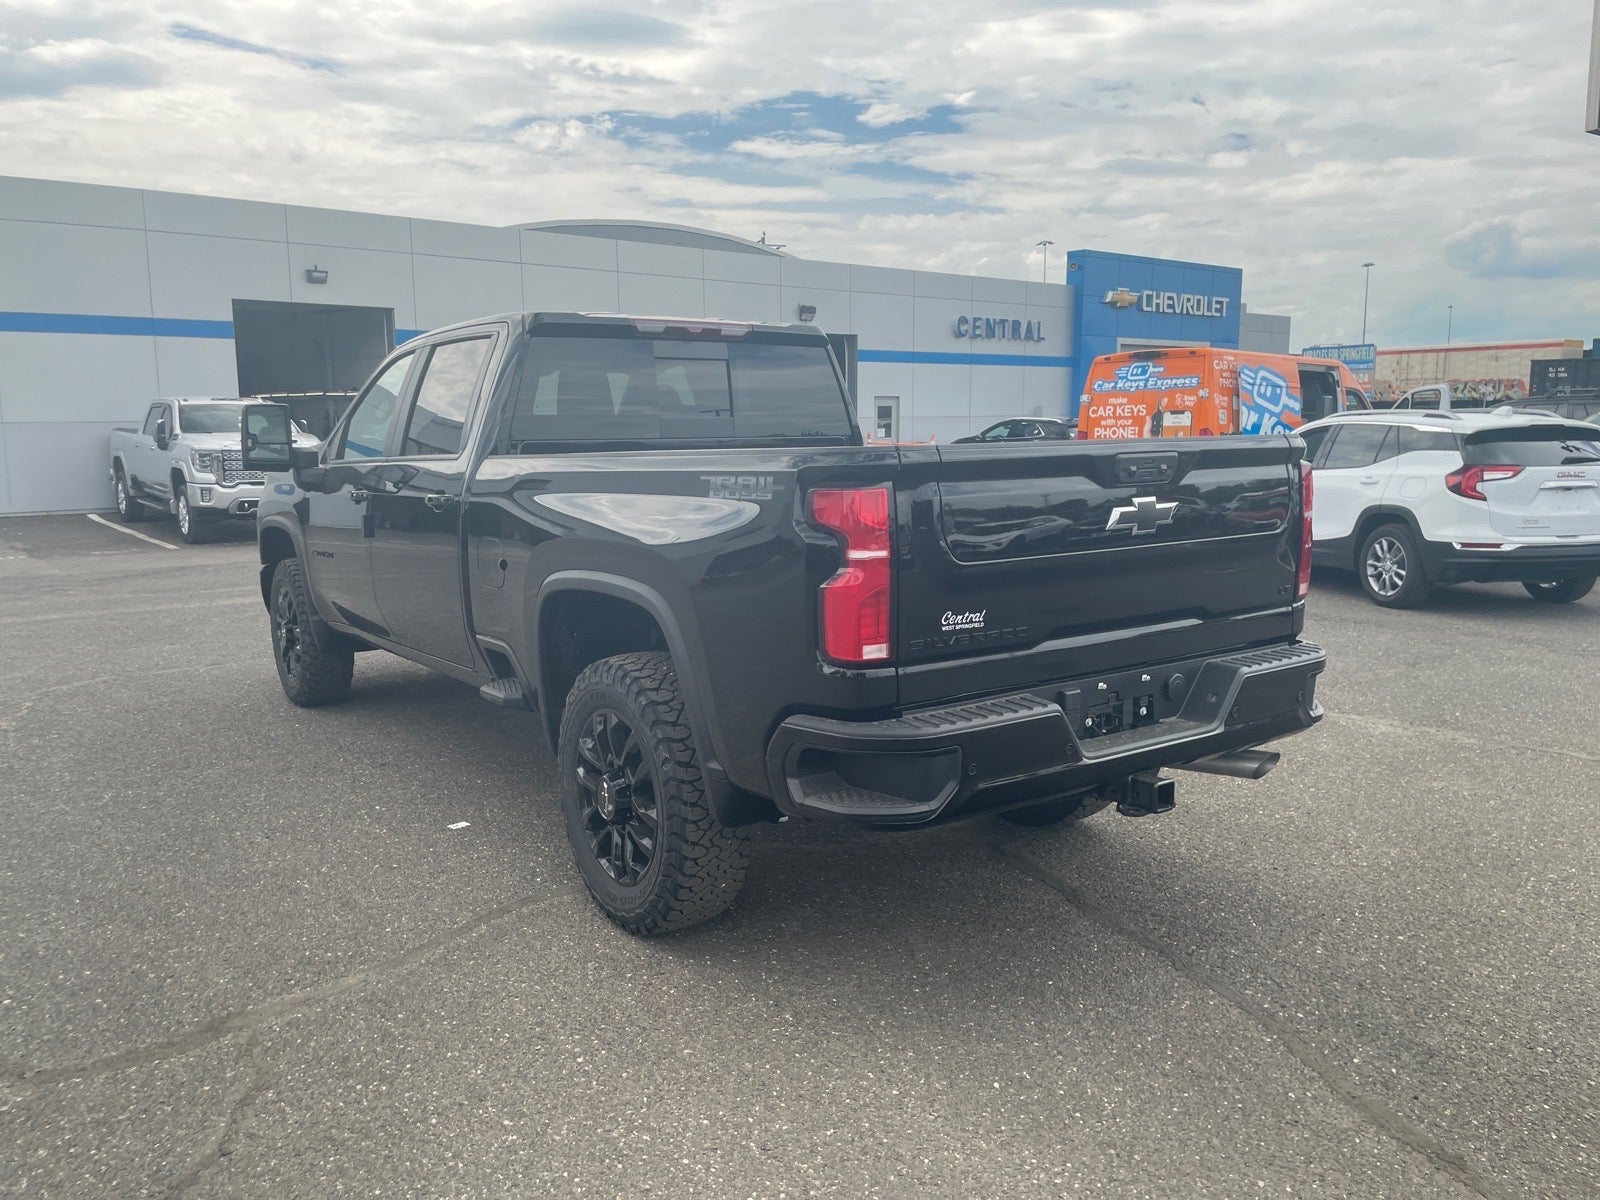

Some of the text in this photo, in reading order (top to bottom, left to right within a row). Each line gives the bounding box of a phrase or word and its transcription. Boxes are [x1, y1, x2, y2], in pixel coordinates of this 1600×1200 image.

[1142, 290, 1229, 317] CHEVROLET
[955, 315, 1045, 341] CENTRAL
[1094, 376, 1199, 391] Car Keys Express
[1108, 396, 1128, 405] make
[1089, 405, 1146, 417] CAR KEYS
[1100, 418, 1133, 427] with your
[1094, 427, 1139, 438] PHONE!
[700, 475, 785, 491] TRAIL
[709, 489, 773, 500] BOSS
[941, 609, 986, 625] Central
[955, 622, 985, 630] SPRINGFIELD
